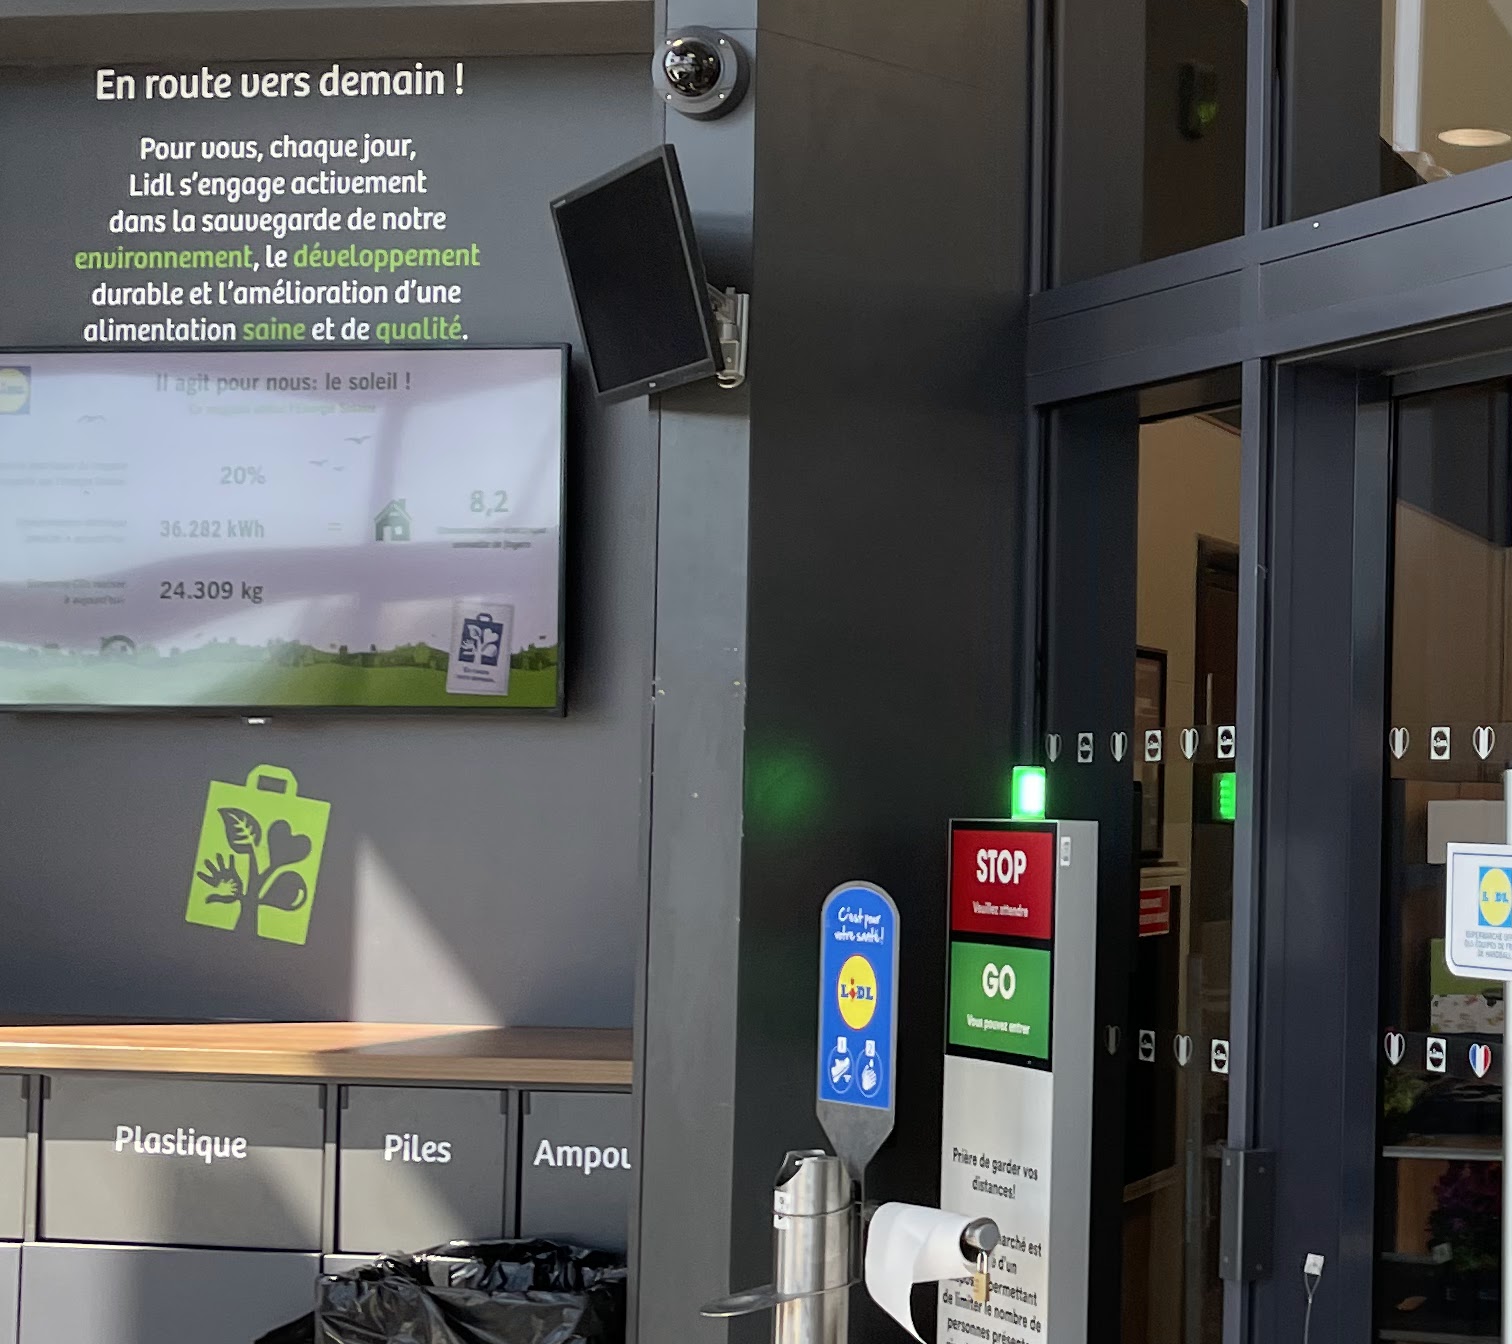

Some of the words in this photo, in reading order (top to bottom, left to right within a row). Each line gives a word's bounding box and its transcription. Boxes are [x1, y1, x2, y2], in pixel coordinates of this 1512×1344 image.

[96, 69, 135, 101] En
[145, 66, 232, 99] route
[240, 70, 310, 98] vers
[319, 63, 445, 97] demain
[455, 63, 464, 95] !
[140, 137, 194, 160] Pour
[201, 140, 263, 163] vous,
[270, 134, 358, 164] chaque
[360, 133, 416, 162] jour,
[129, 172, 174, 197] Lidl
[291, 169, 427, 196] activement
[108, 209, 166, 233] dans
[173, 208, 196, 232] la
[201, 208, 342, 239] sauvegarde
[347, 207, 377, 231] de
[382, 209, 447, 231] notre
[75, 249, 260, 274] environnement,
[265, 245, 288, 269] le
[293, 242, 481, 271] développement
[91, 282, 184, 307] durable
[189, 283, 213, 305] et
[83, 317, 236, 343] alimentation
[242, 317, 306, 341] saine
[312, 318, 336, 340] et
[341, 316, 370, 340] de
[376, 313, 469, 346] qualité.
[175, 371, 210, 396] agit
[216, 374, 261, 396] pour
[266, 373, 319, 392] nous:
[325, 372, 343, 391] le
[348, 372, 398, 391] soleil
[220, 466, 267, 486] 20%
[470, 490, 509, 517] 8,2
[227, 519, 265, 539] kWh
[160, 581, 234, 600] 24.309
[241, 580, 264, 604] kg
[976, 849, 1027, 884] STOP
[982, 963, 1016, 1000] GO
[115, 1125, 248, 1164] Plastique
[384, 1133, 452, 1164] Piles
[953, 1147, 977, 1166] Prière
[980, 1153, 990, 1168] de
[992, 1159, 1021, 1175] garder
[1023, 1168, 1038, 1181] vos
[972, 1176, 1016, 1200] distances!
[1028, 1241, 1042, 1257] est
[943, 1289, 953, 1305] de
[955, 1291, 982, 1313] limiter
[993, 1306, 1027, 1328] nombre
[1030, 1315, 1042, 1333] de
[947, 1317, 990, 1340] personnes
